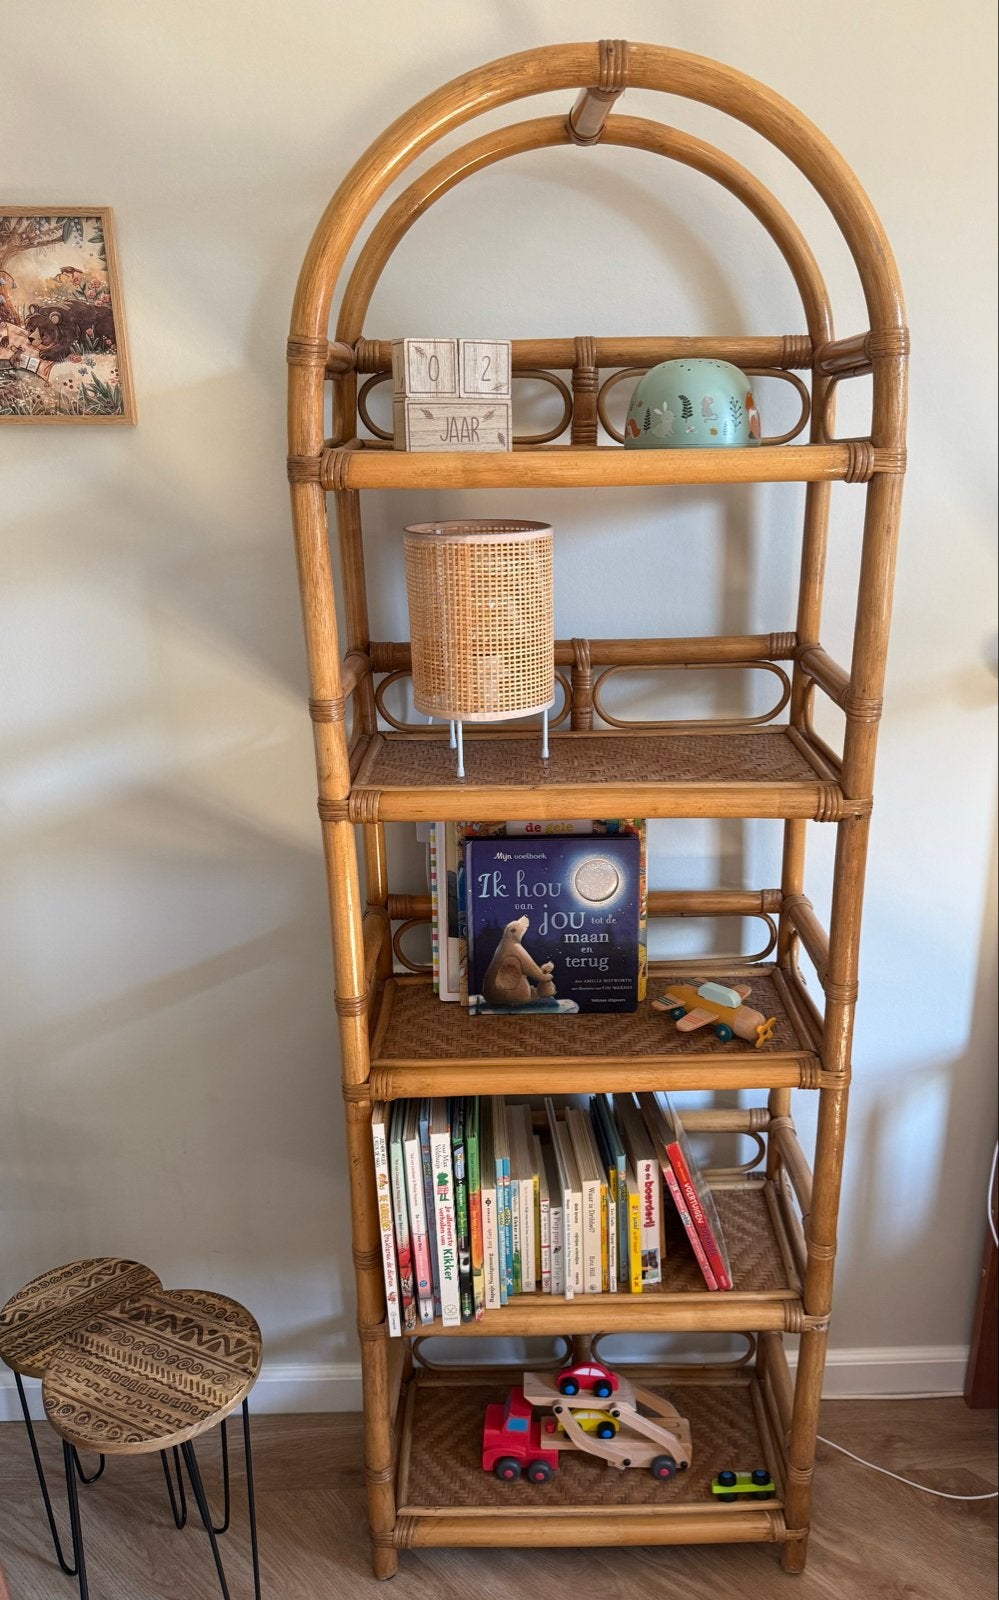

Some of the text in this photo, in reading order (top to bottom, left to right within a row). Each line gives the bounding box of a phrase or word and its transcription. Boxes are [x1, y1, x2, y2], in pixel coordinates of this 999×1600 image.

[428, 355, 491, 382] 0 2
[440, 416, 480, 443] JAAR
[525, 822, 574, 834] de gele
[493, 851, 547, 862] Mijn voelboek
[478, 869, 562, 898] Ik hou
[538, 903, 617, 936] jou tot de
[564, 933, 610, 943] maan
[565, 957, 609, 971] terug
[433, 1144, 442, 1169] Velthuijs
[645, 1164, 651, 1172] Op
[642, 1181, 656, 1228] boerderij
[684, 1182, 704, 1224] VOERTUIGEN
[438, 1208, 446, 1234] verhalen
[446, 1214, 454, 1247] allereerste
[443, 1248, 455, 1281] Kikker
[488, 1285, 497, 1303] Rupsje
